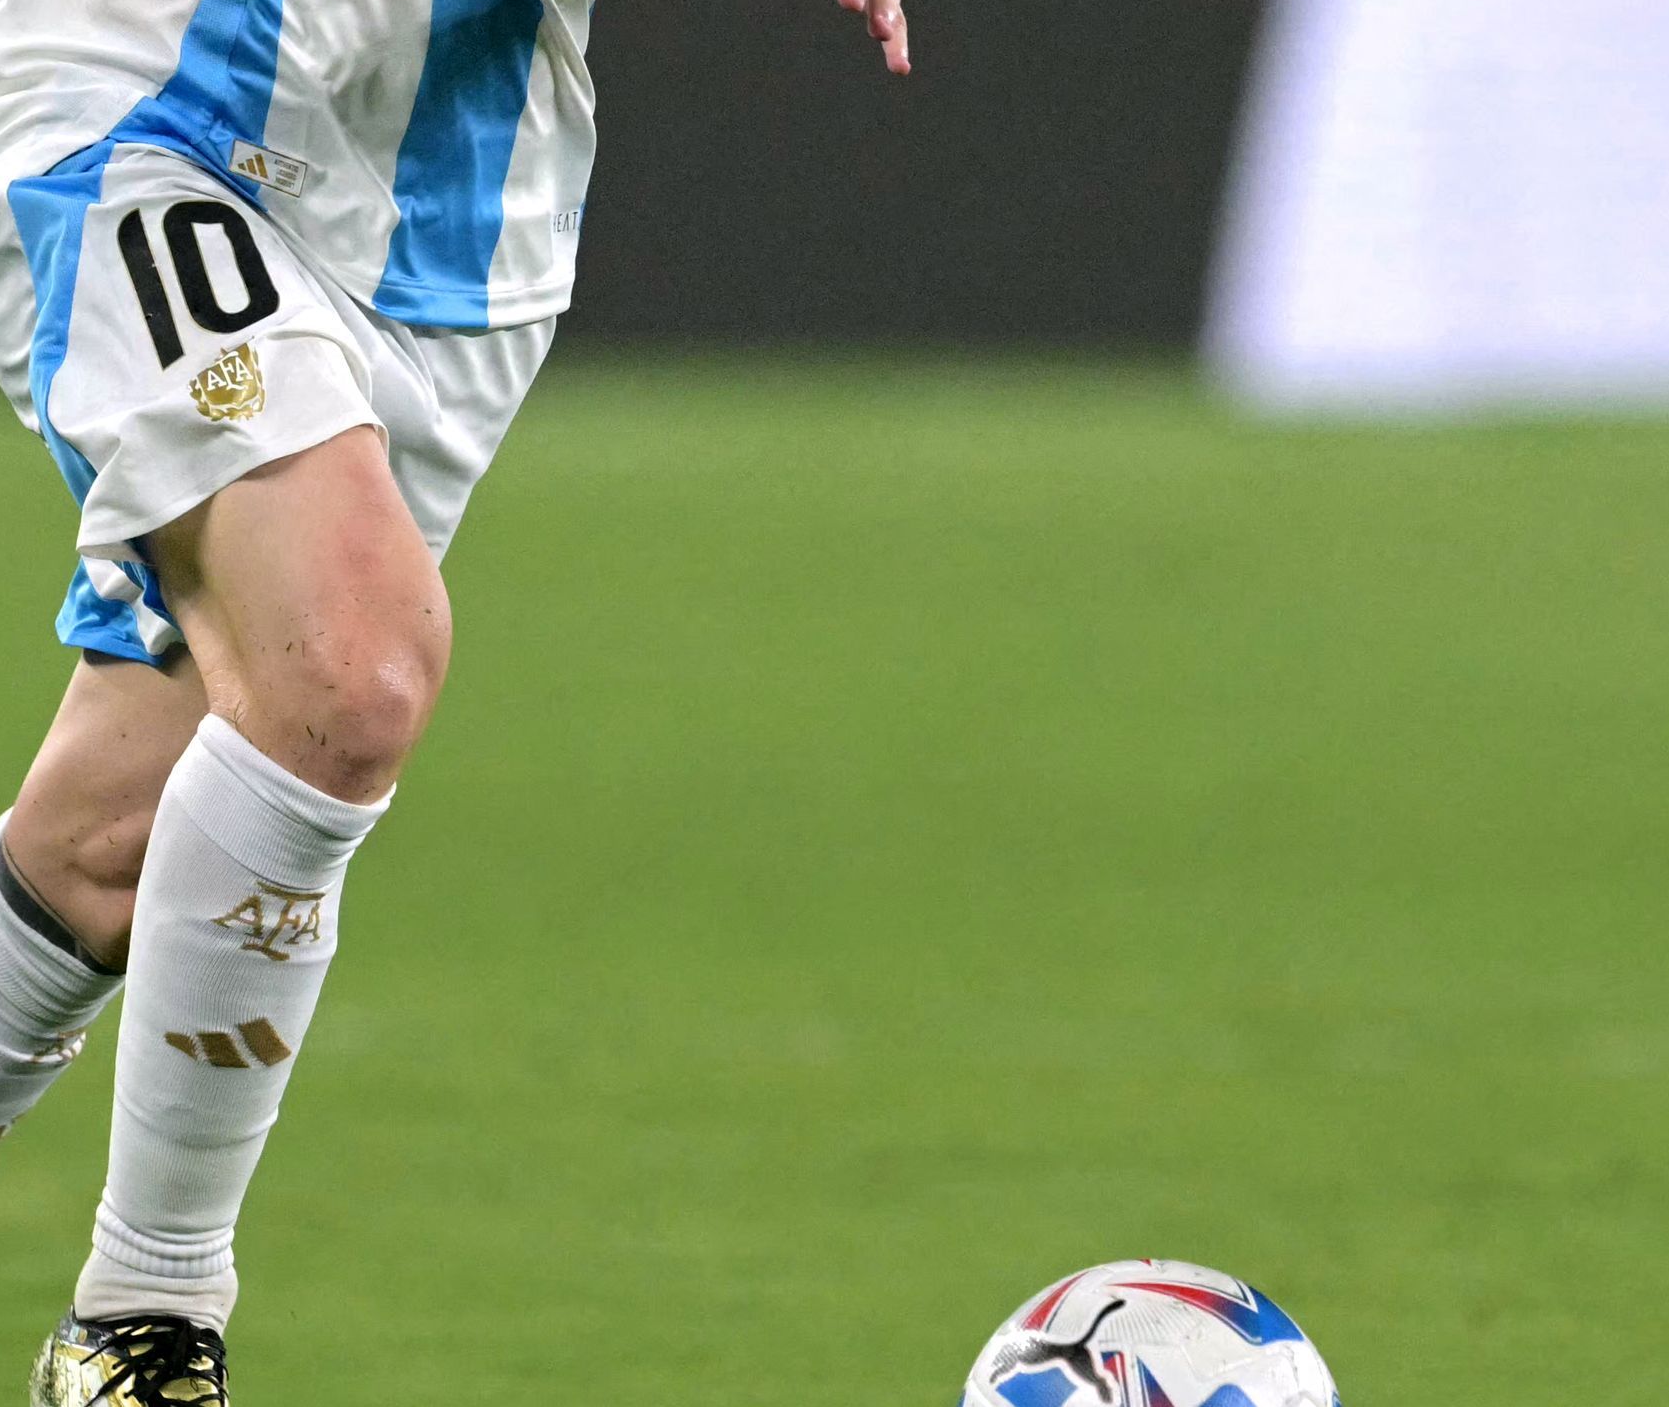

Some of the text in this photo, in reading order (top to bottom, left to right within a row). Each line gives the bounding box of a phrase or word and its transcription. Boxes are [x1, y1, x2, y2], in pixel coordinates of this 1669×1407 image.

[117, 201, 281, 371] 10
[207, 351, 254, 391] AFA
[211, 880, 327, 962] AFA
